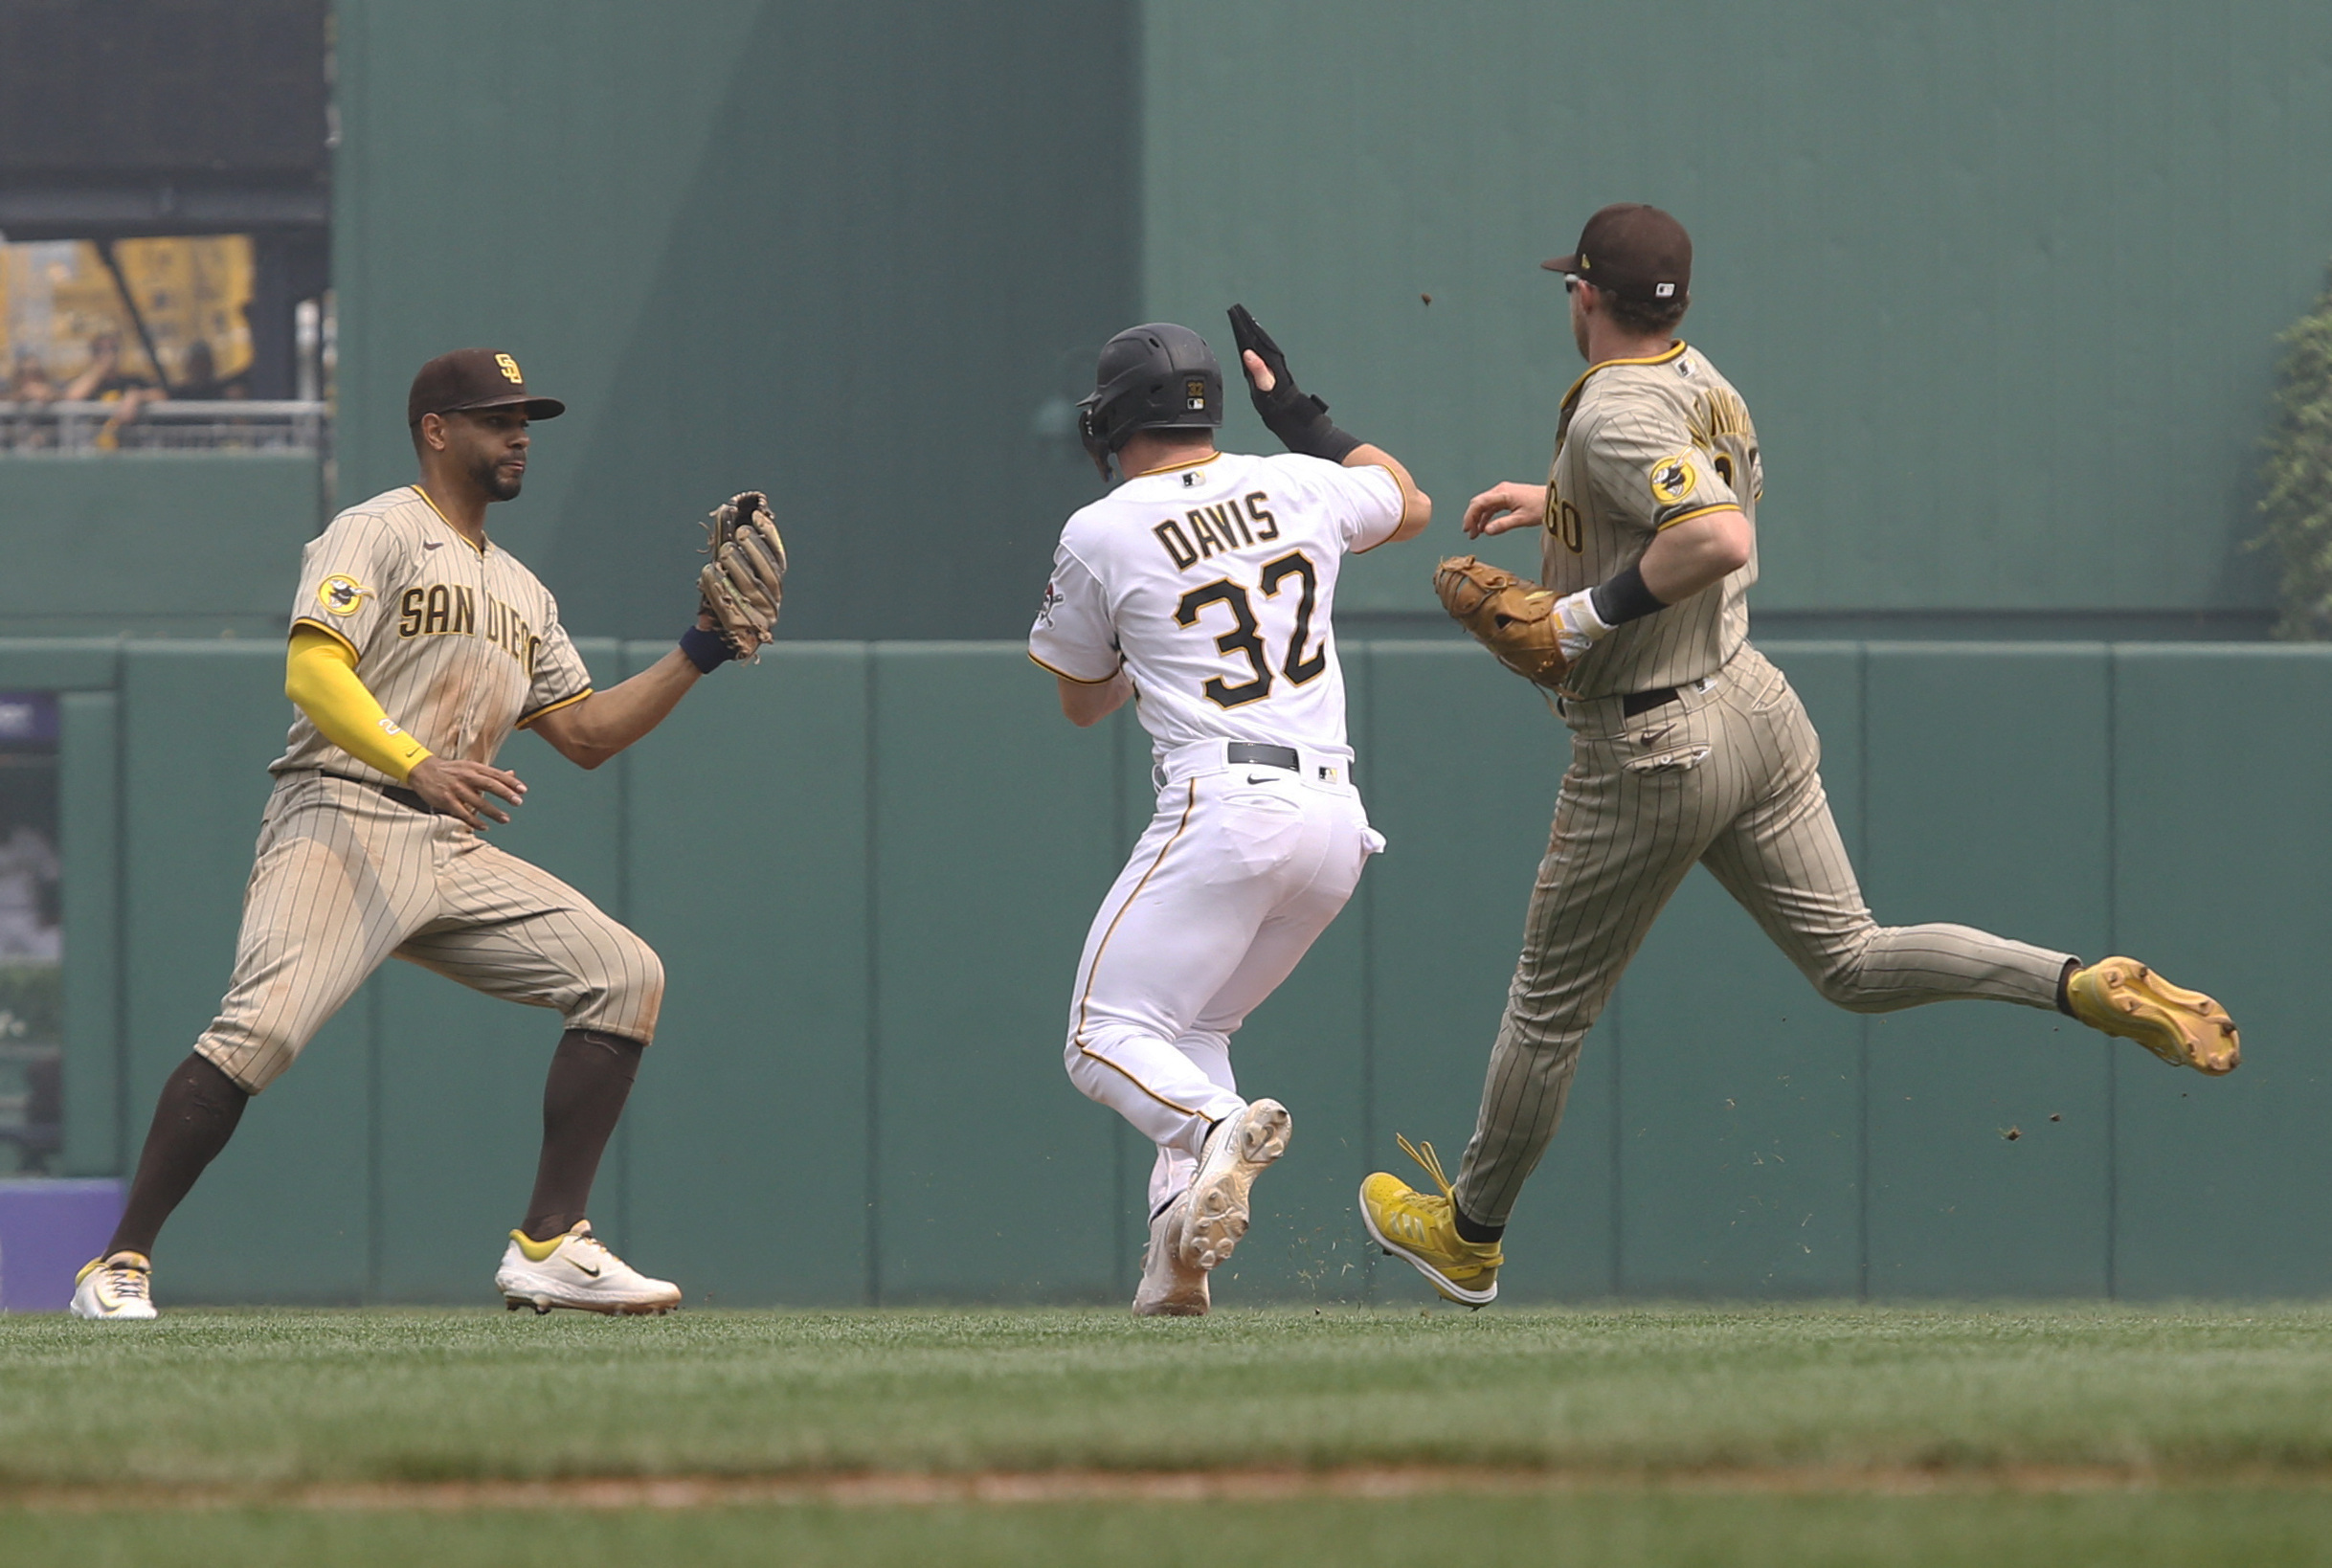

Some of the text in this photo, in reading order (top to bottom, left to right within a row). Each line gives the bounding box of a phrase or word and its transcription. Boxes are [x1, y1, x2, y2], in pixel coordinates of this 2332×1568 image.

[1152, 490, 1280, 572] DAVIS
[398, 584, 475, 639] SAN
[1171, 548, 1326, 711] 32
[378, 718, 401, 736] 2
